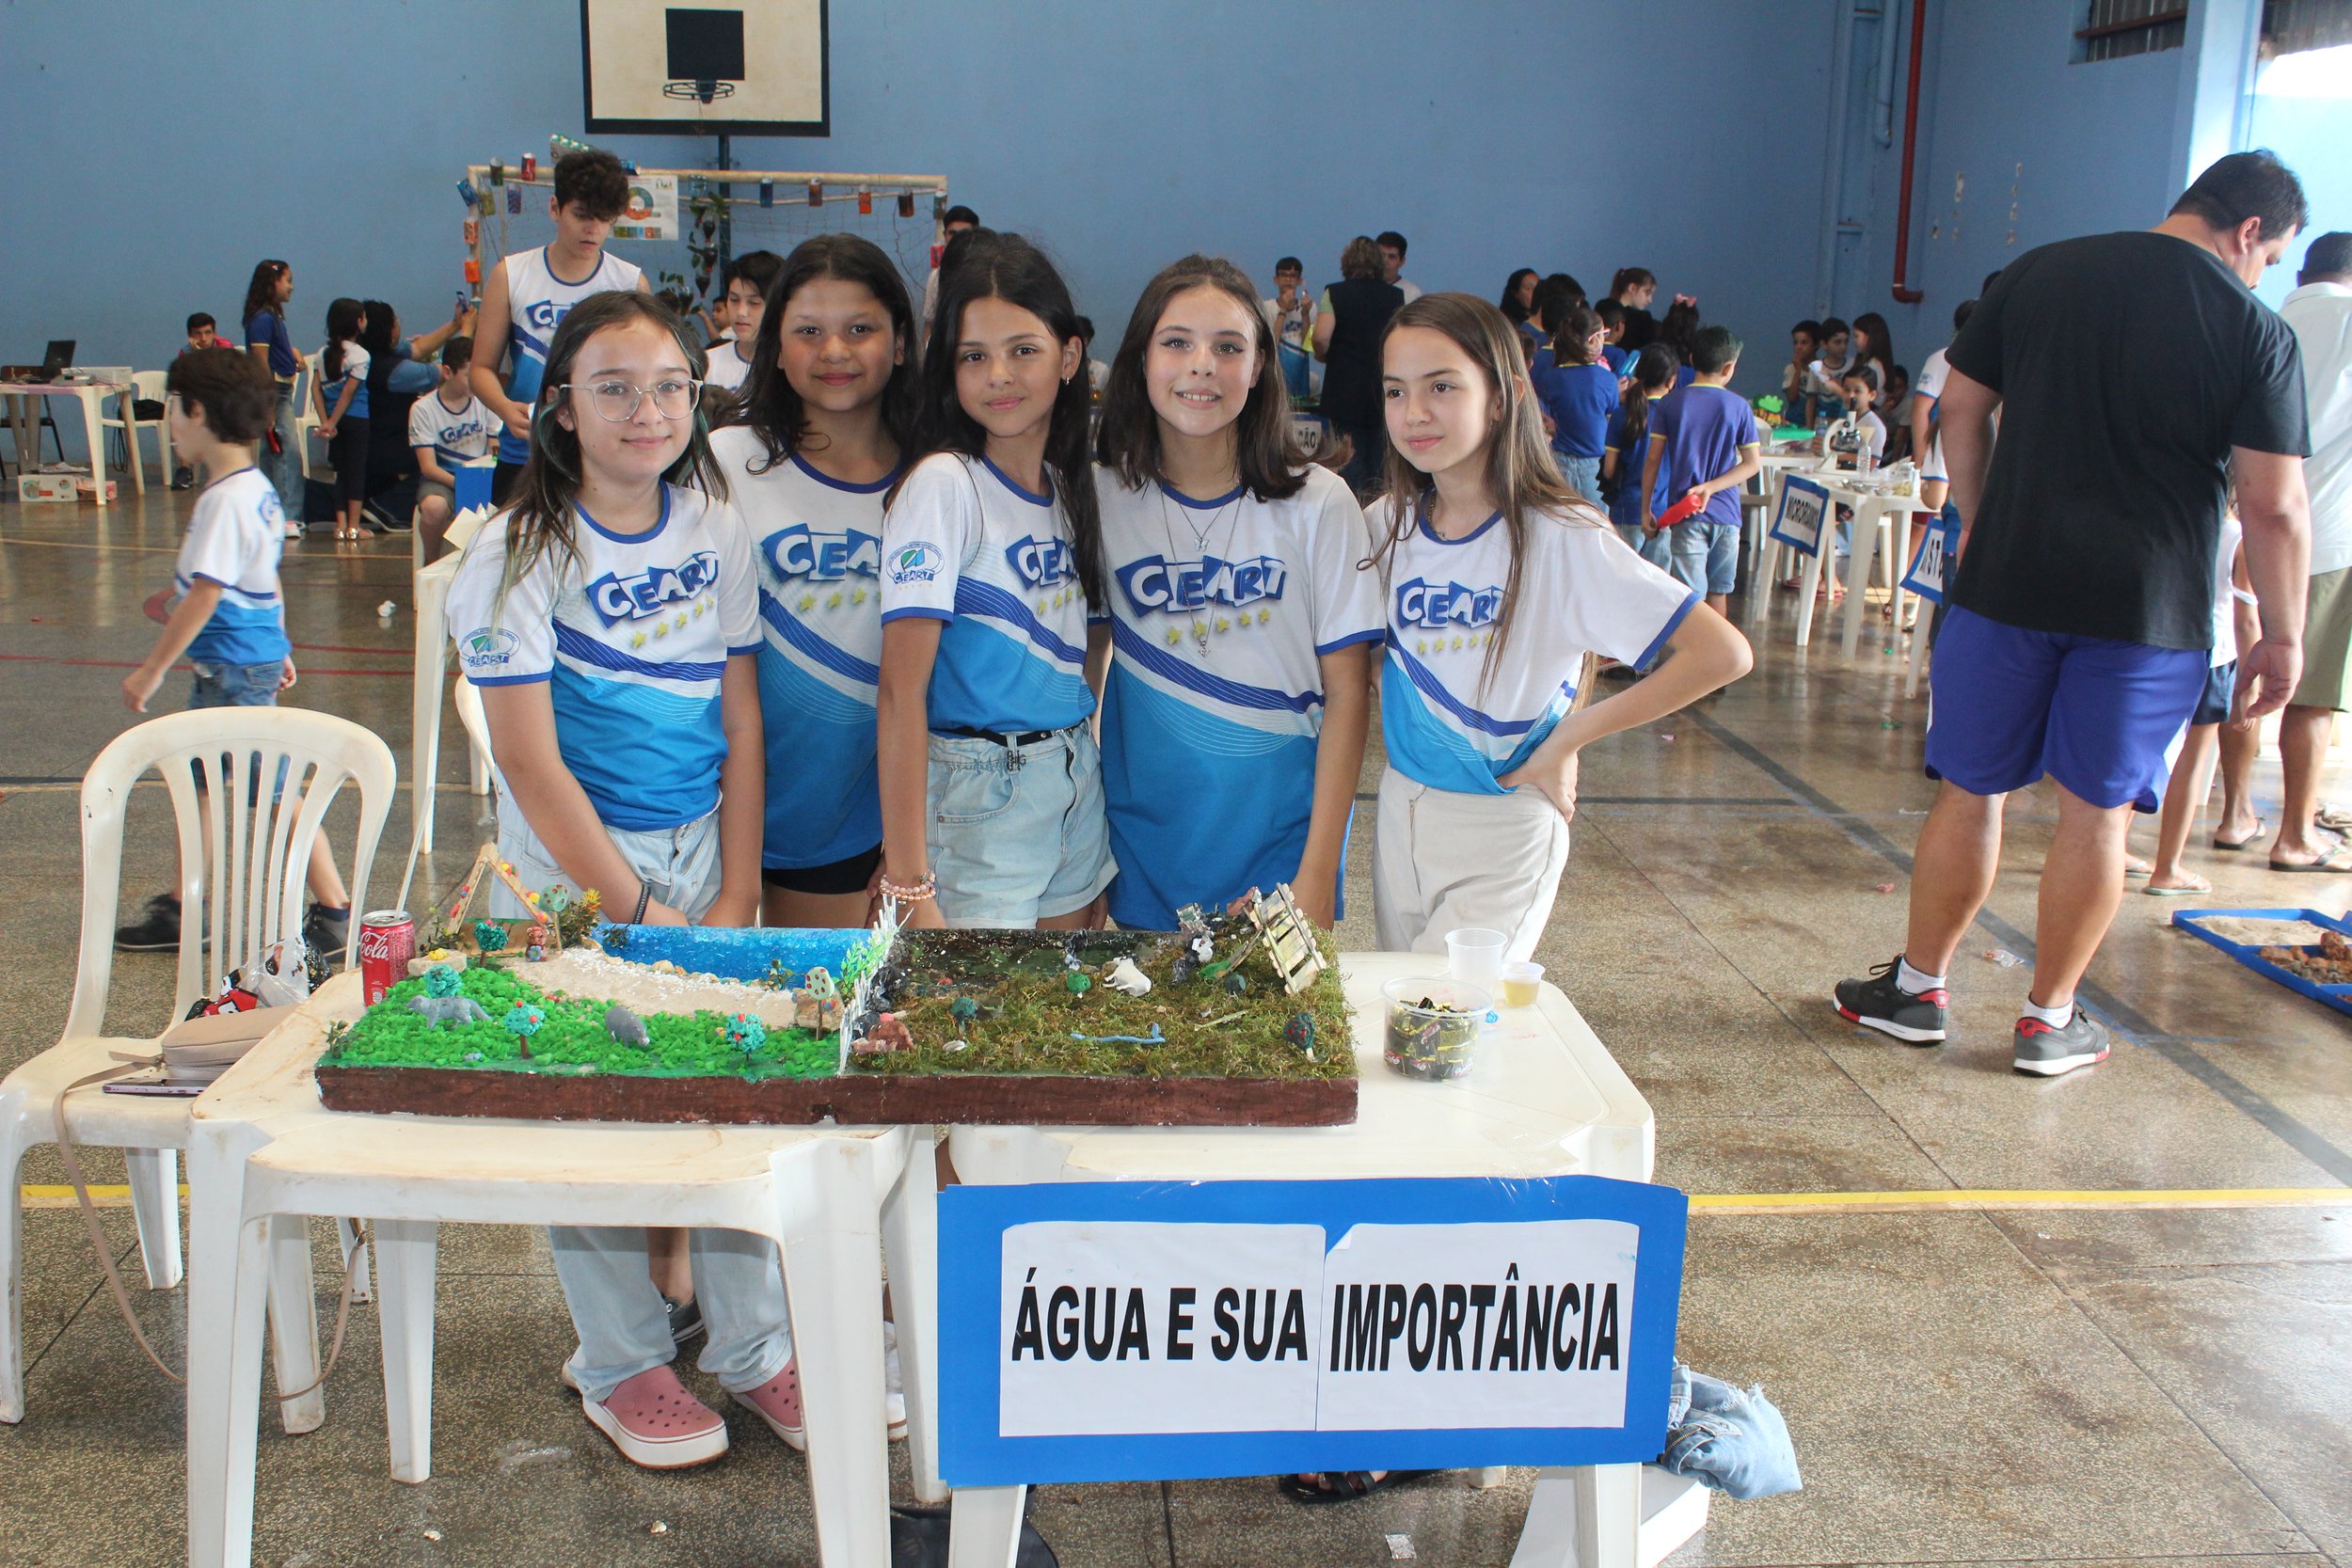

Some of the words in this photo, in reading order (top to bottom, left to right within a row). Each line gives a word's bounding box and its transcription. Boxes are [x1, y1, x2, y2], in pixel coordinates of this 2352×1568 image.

[774, 532, 882, 578] CEA
[894, 569, 934, 583] CEART
[1016, 543, 1075, 582] CEA
[596, 551, 721, 618] CEART
[1129, 559, 1287, 609] CEART
[1011, 1266, 1151, 1362] ÁGUA
[1167, 1287, 1197, 1361] E
[1210, 1287, 1309, 1362] SUA
[1329, 1262, 1620, 1372] IMPORTÂNCIA
